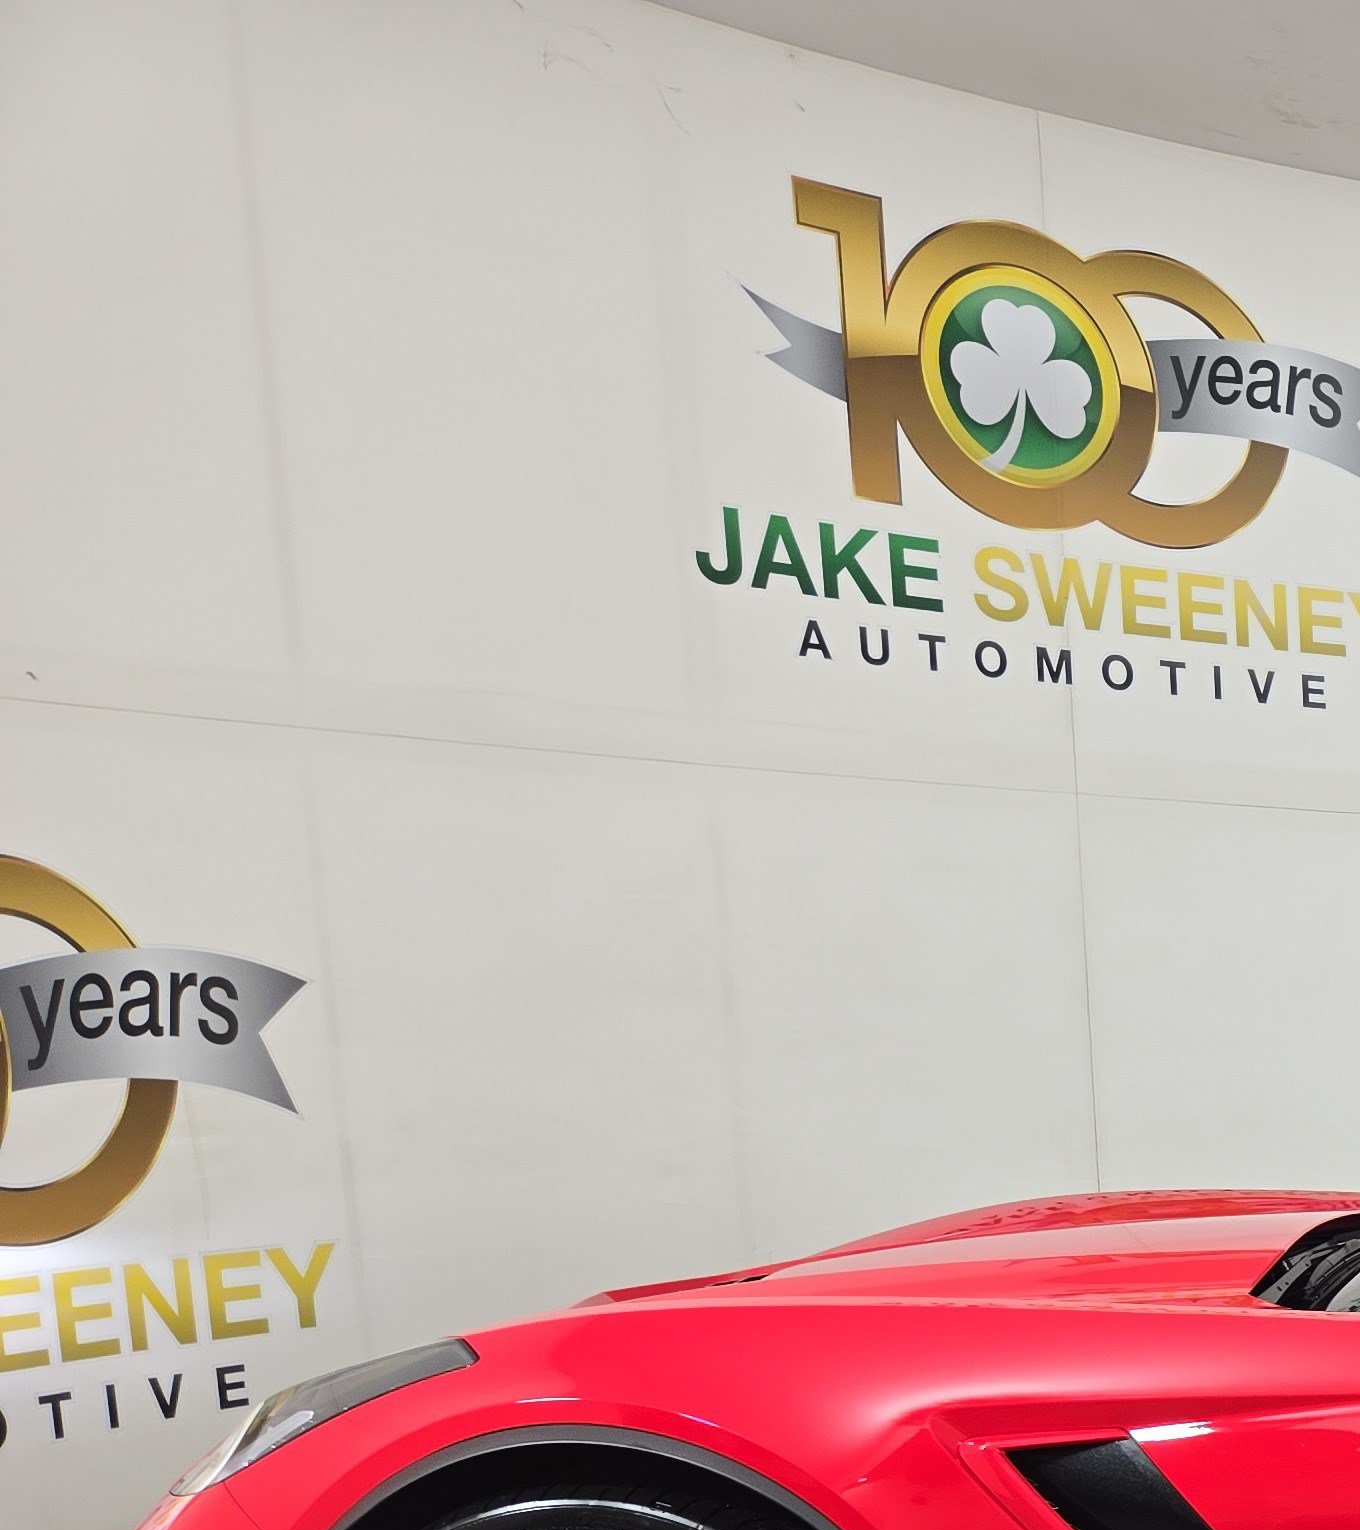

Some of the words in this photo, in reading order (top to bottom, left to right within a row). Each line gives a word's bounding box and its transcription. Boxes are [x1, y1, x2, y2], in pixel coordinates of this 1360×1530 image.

[791, 175, 1290, 550] 100
[1169, 353, 1344, 429] years
[695, 505, 945, 614] JAKE
[798, 619, 1328, 710] AUTOMOTIVE
[19, 969, 239, 1071] years
[0, 1364, 250, 1450] TIVE
